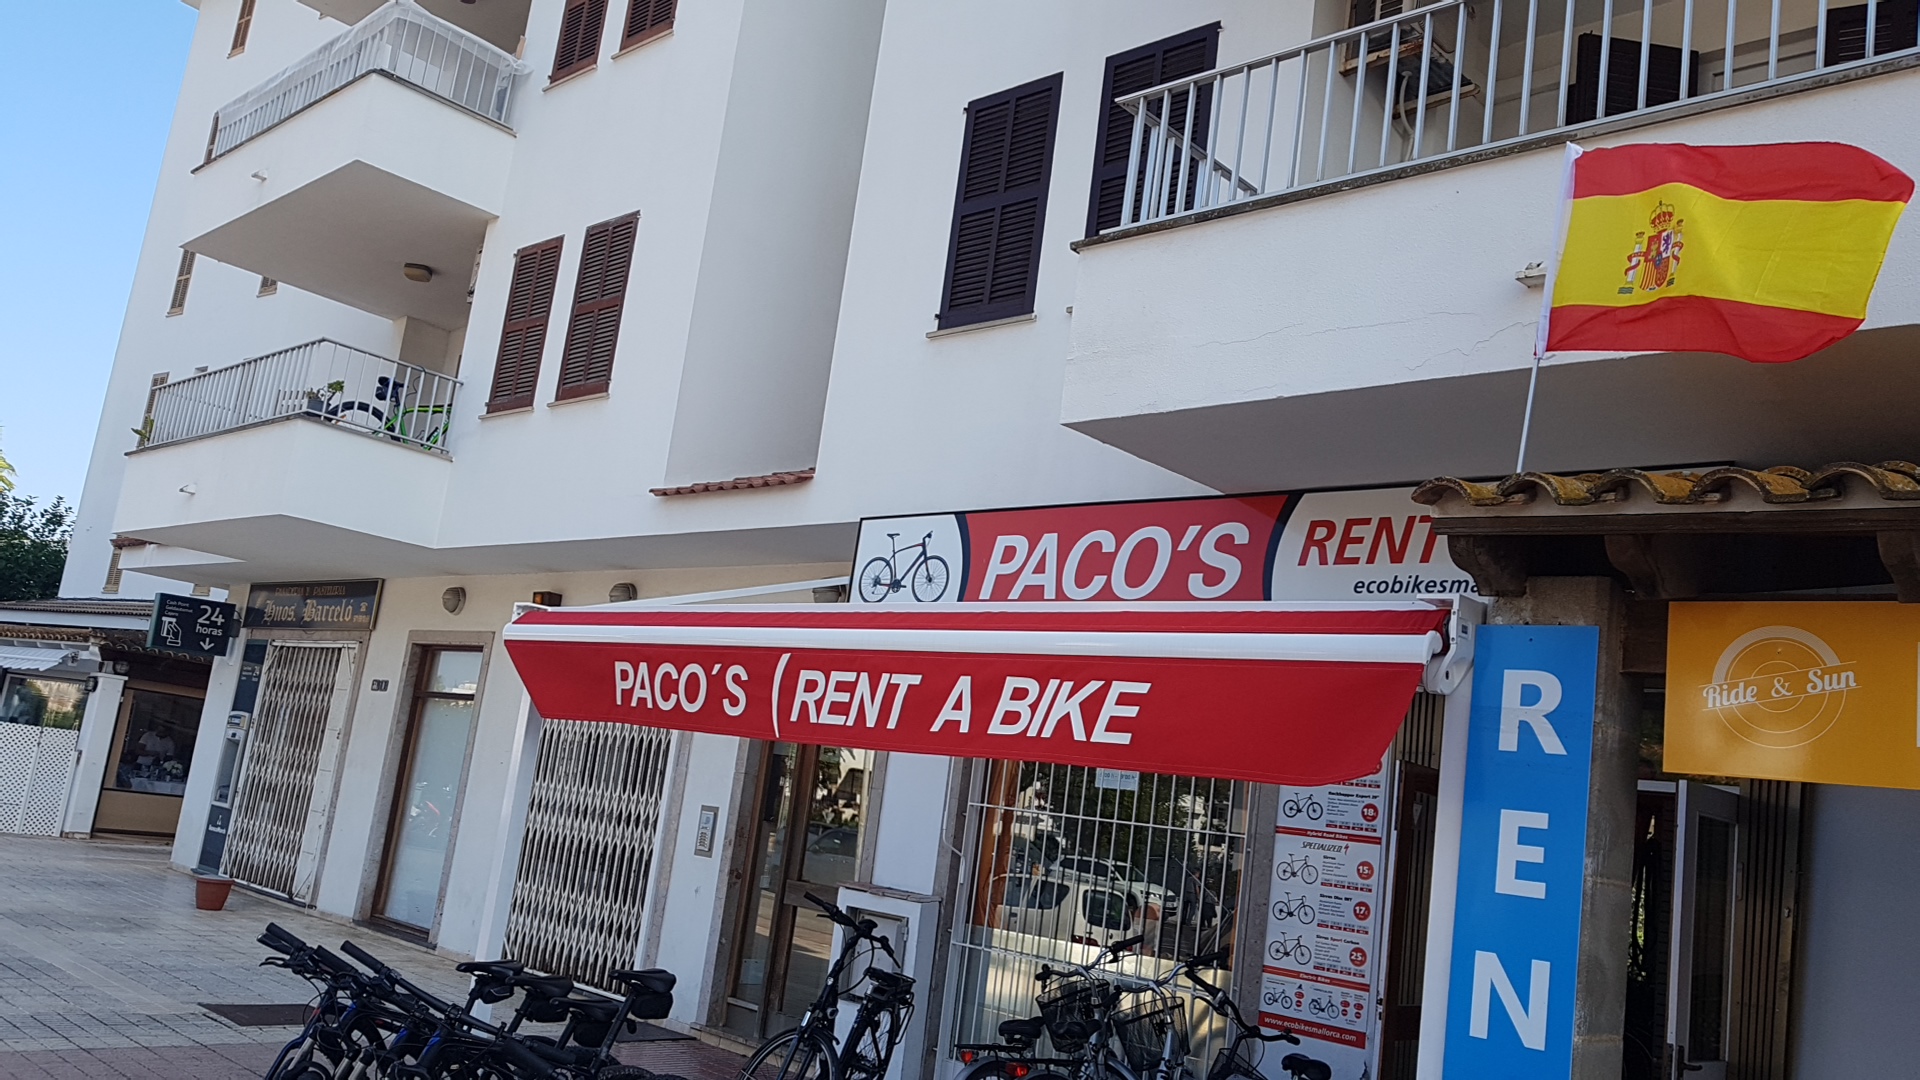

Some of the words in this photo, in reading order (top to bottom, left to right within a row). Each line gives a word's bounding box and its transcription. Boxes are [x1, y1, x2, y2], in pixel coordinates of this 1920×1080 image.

[1297, 515, 1436, 566] RENT
[979, 521, 1250, 600] PACO'S
[195, 623, 223, 636] horas
[197, 604, 225, 626] 24
[1702, 681, 1758, 708] Ride
[1771, 676, 1794, 698] &
[1806, 668, 1857, 694] Sun
[930, 675, 972, 733] A
[987, 676, 1152, 745] BIKE
[1301, 841, 1343, 853] SPECIALIZED
[1264, 1016, 1358, 1042] www.ecobikesmallorca.com
